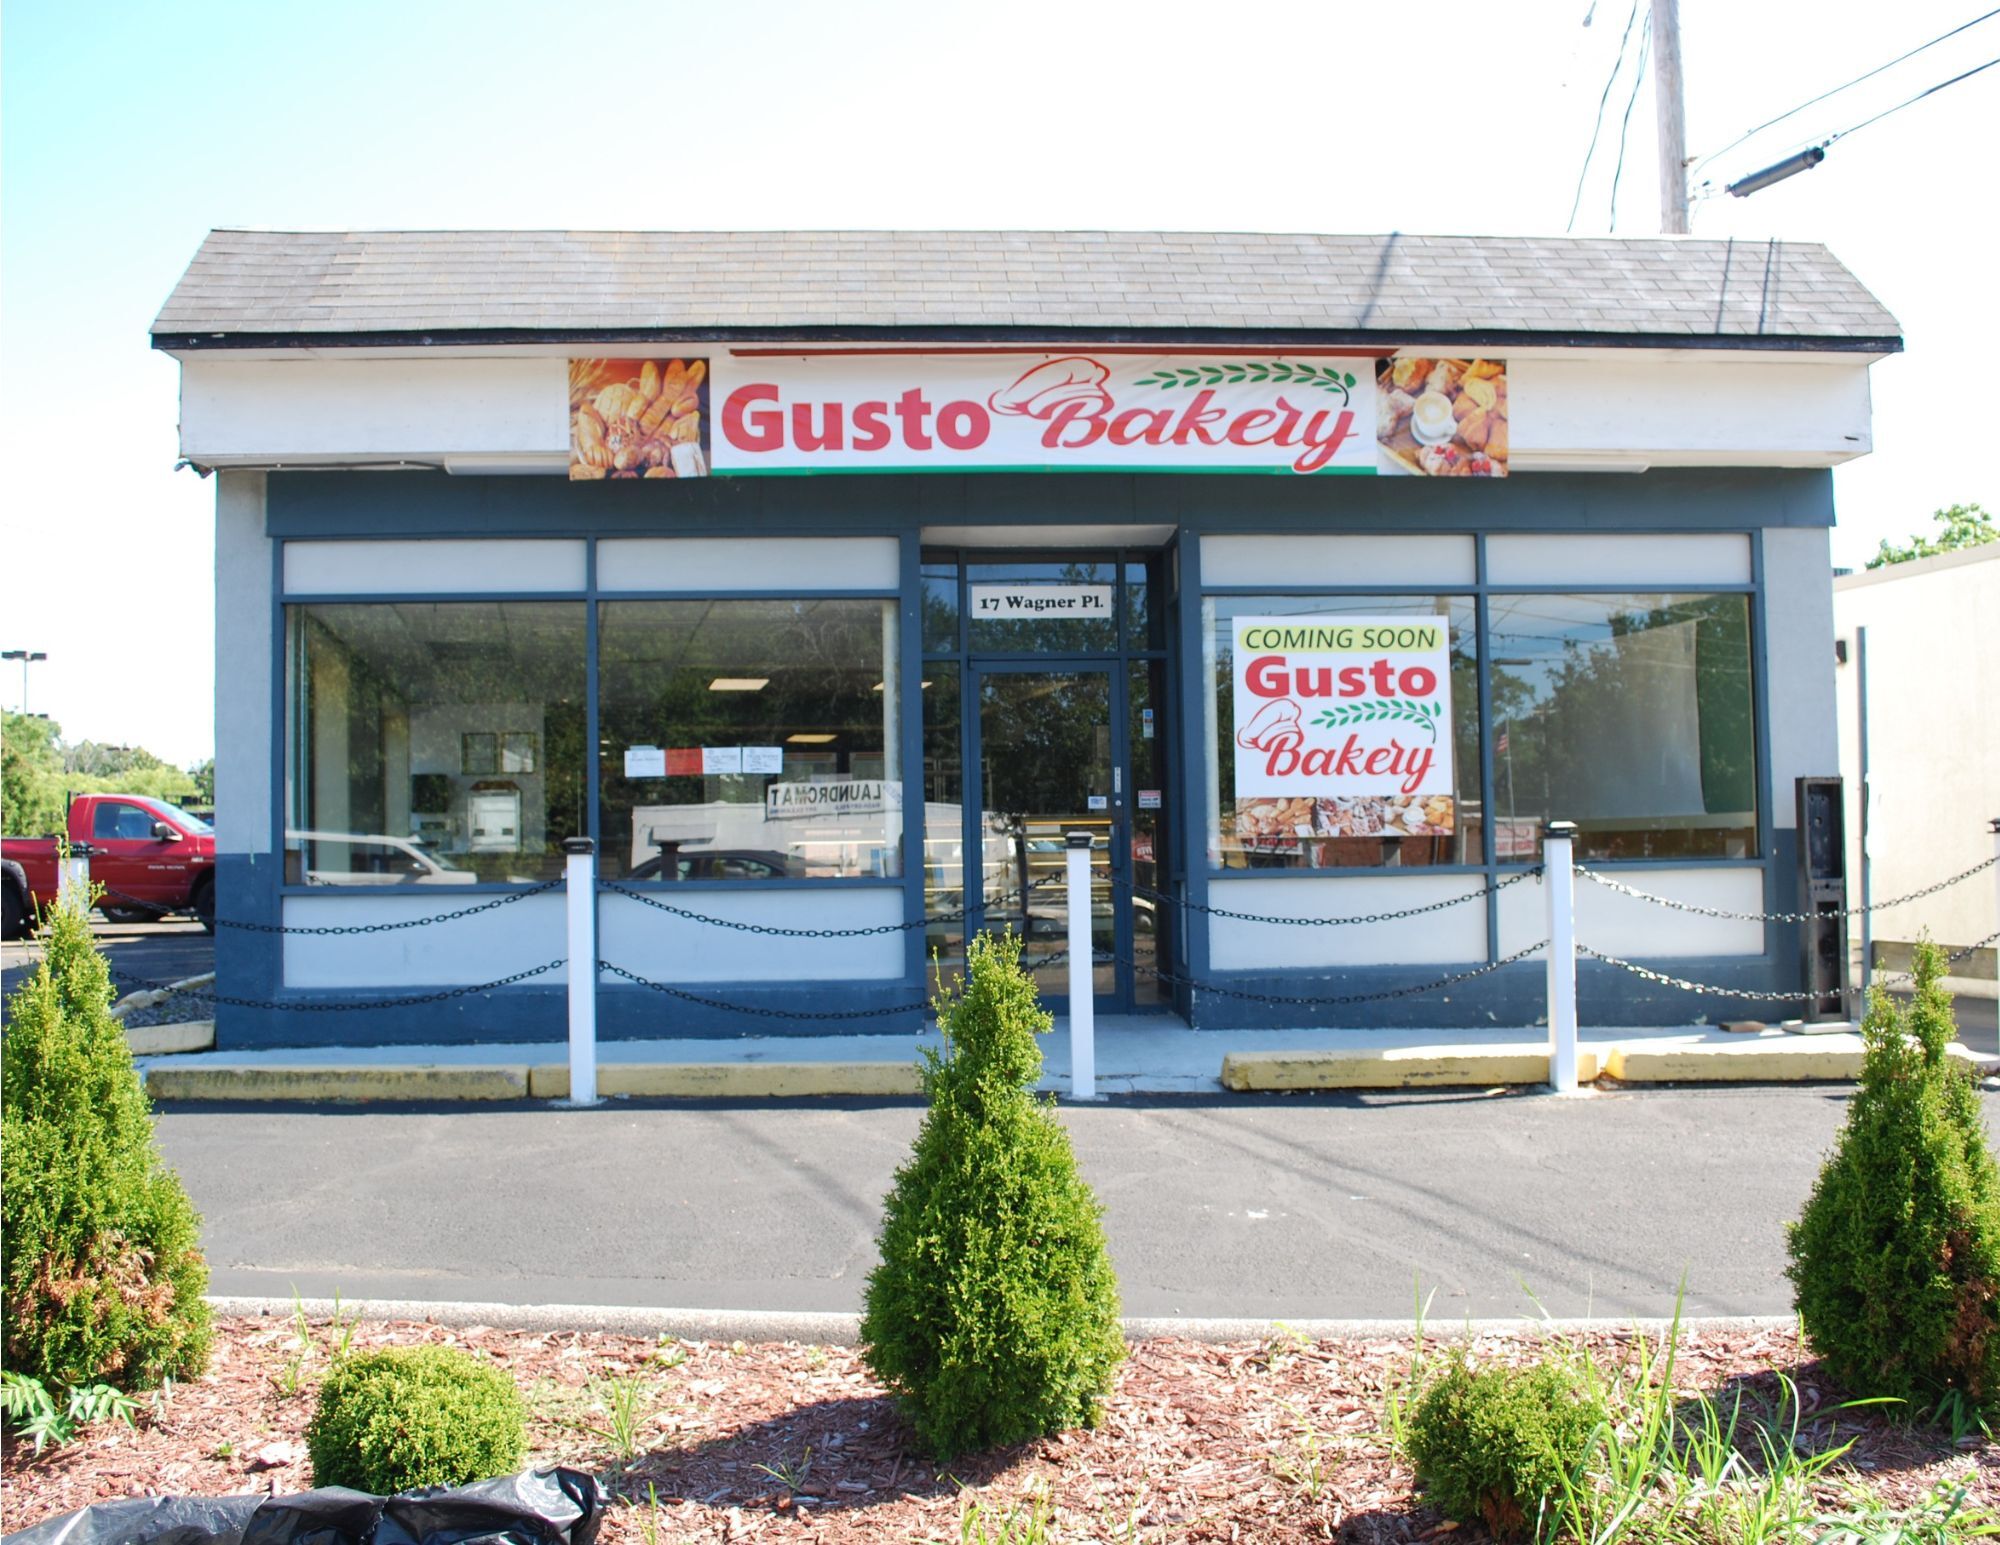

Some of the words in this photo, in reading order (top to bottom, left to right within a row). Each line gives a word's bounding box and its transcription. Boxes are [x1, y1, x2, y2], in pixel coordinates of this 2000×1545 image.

[722, 384, 991, 453] Gusto
[1040, 389, 1358, 473] Bakery
[979, 597, 999, 611] 17
[1006, 595, 1076, 612] Wagner
[1082, 595, 1104, 609] Pl.
[1246, 629, 1353, 649] COMING
[1362, 628, 1435, 649] SOON
[1246, 656, 1437, 699] Gusto
[1264, 730, 1437, 796] Bakery
